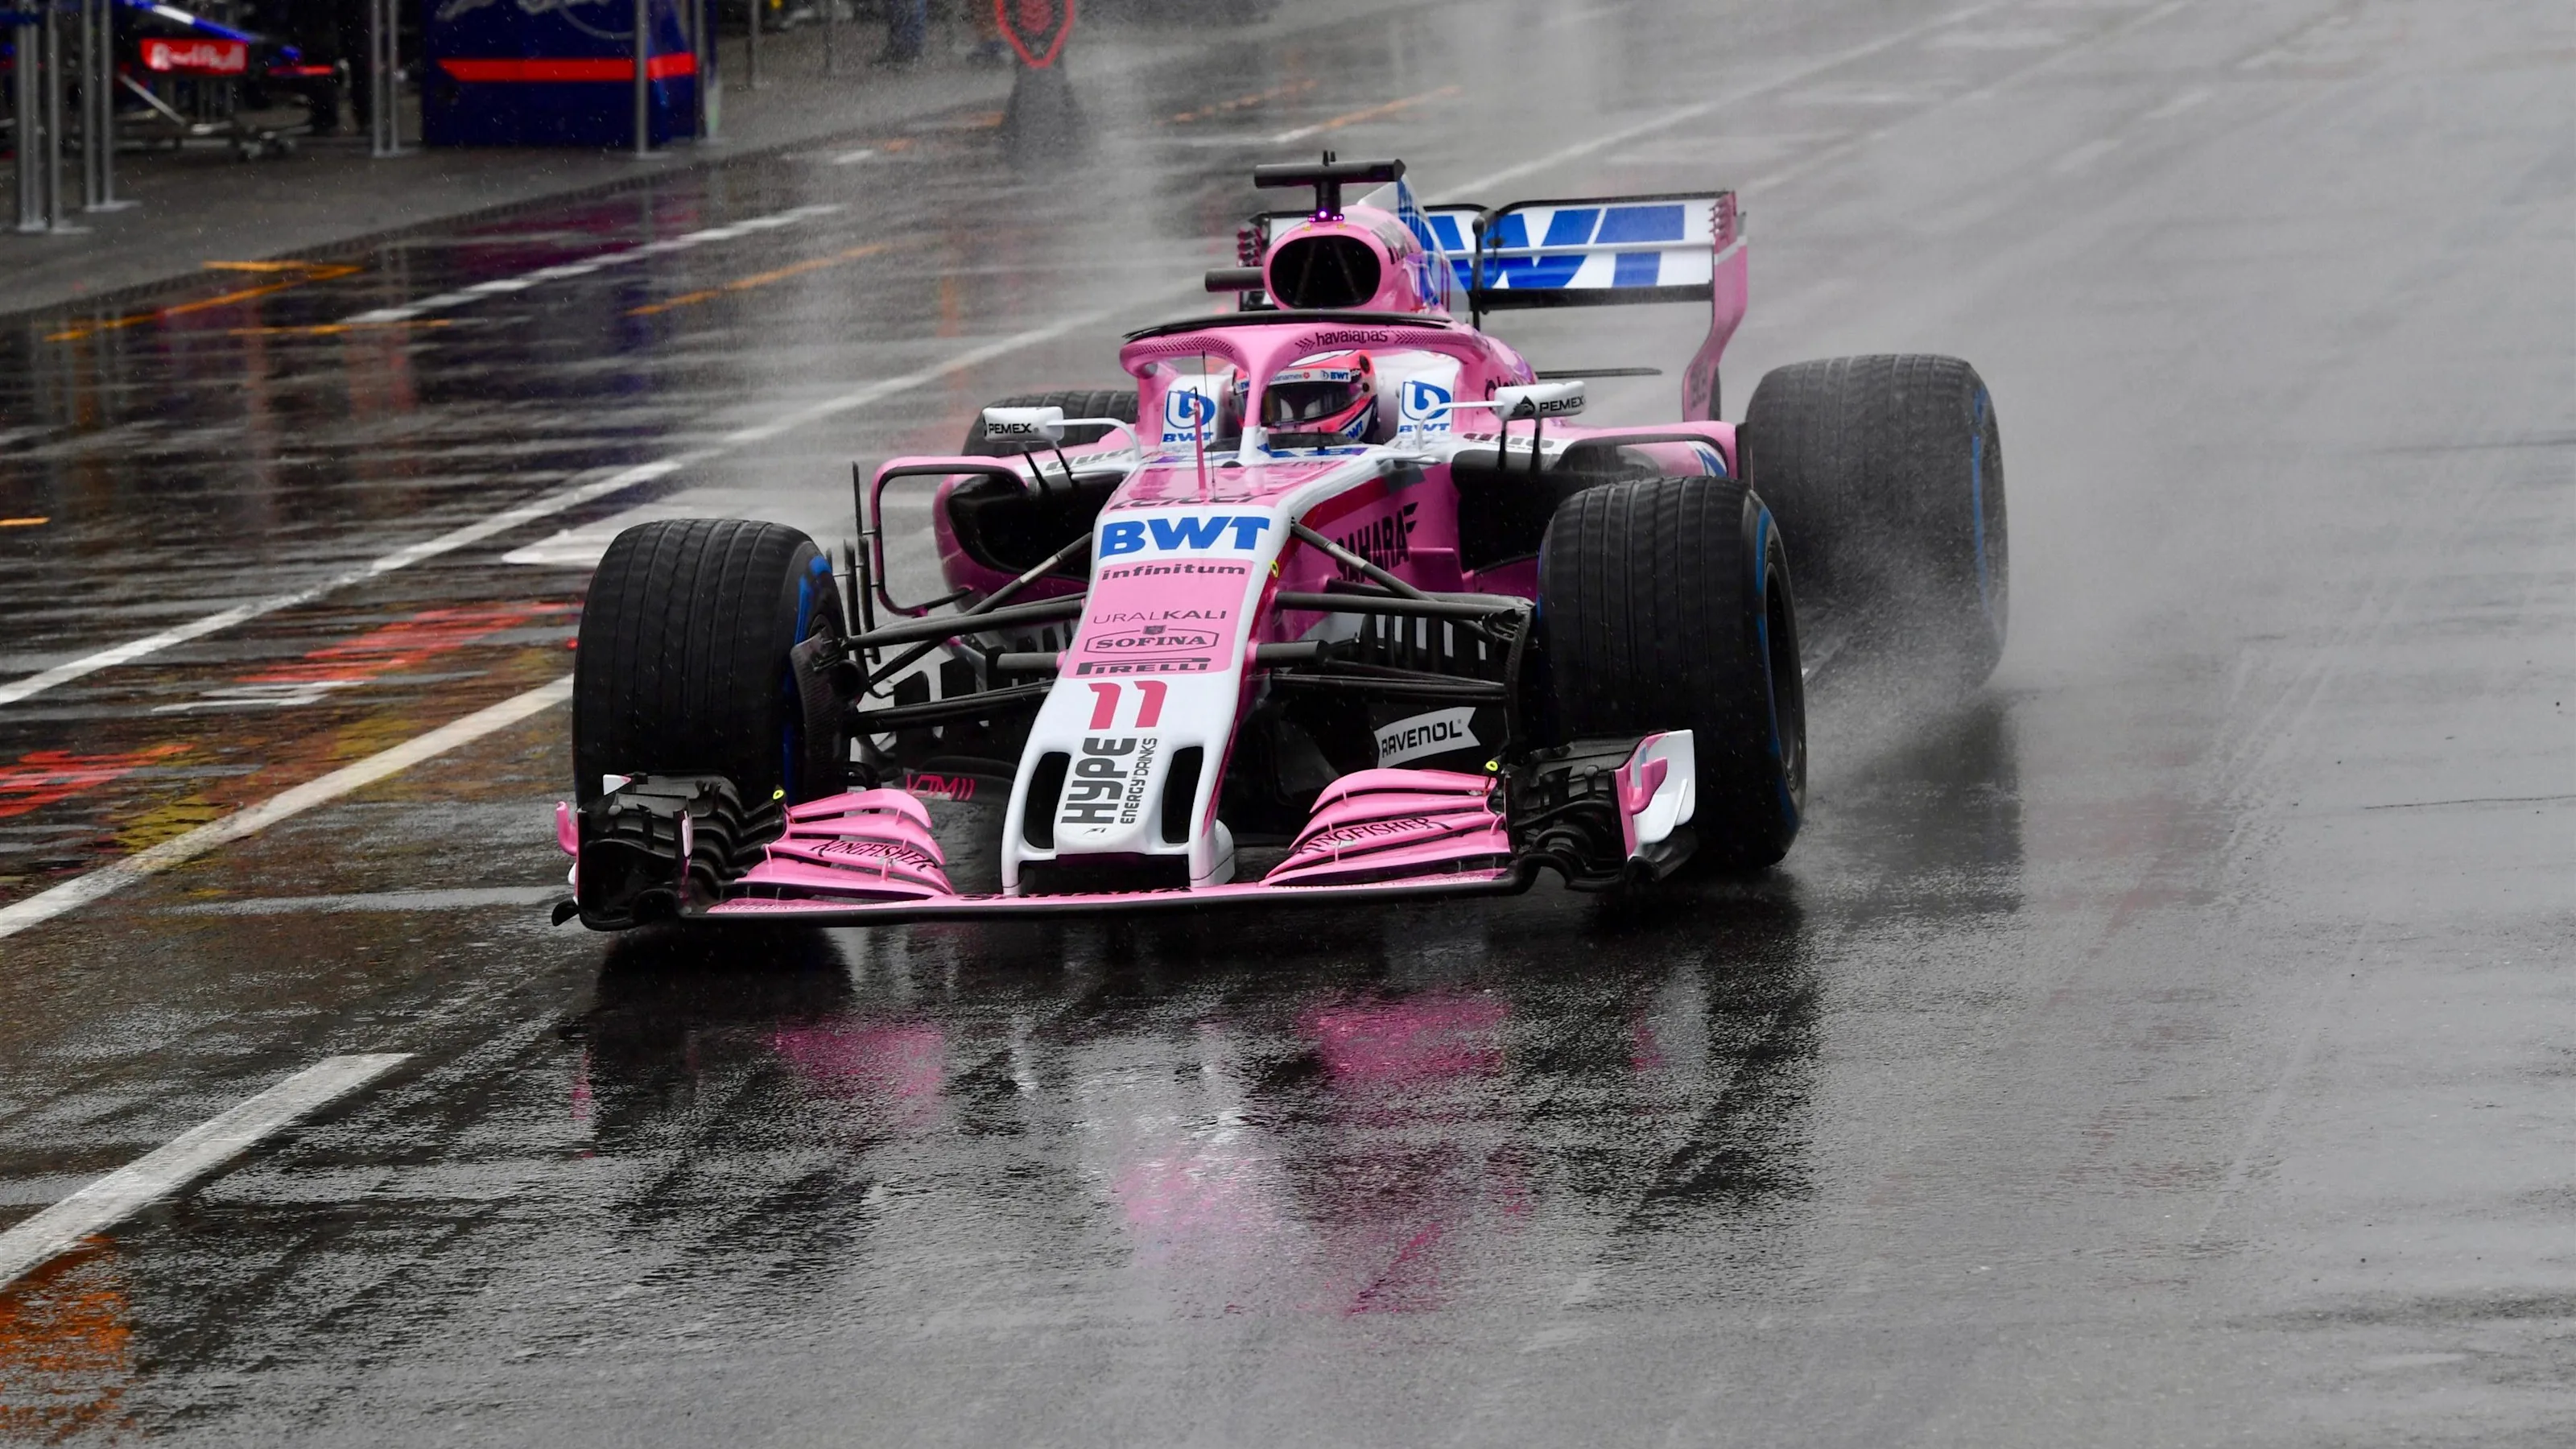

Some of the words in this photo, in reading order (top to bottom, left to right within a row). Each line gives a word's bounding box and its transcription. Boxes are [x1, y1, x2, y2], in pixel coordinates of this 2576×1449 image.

[1315, 331, 1388, 347] havaianas
[1331, 372, 1350, 380] BWT
[1539, 395, 1584, 413] PEMEX
[989, 423, 1032, 434] PEMEX
[1163, 431, 1213, 442] BWT
[1098, 516, 1270, 560] BWT
[1102, 564, 1246, 580] infinitum
[1093, 610, 1226, 624] URALKALI
[1096, 635, 1208, 649] SOFINA
[1076, 658, 1212, 675] PIRELLI
[1088, 679, 1167, 729] 11
[1381, 720, 1463, 758] RAVENOL
[1133, 737, 1158, 776] DRINKS
[1061, 737, 1137, 824] HYPE
[809, 840, 939, 872] KINGFISHER
